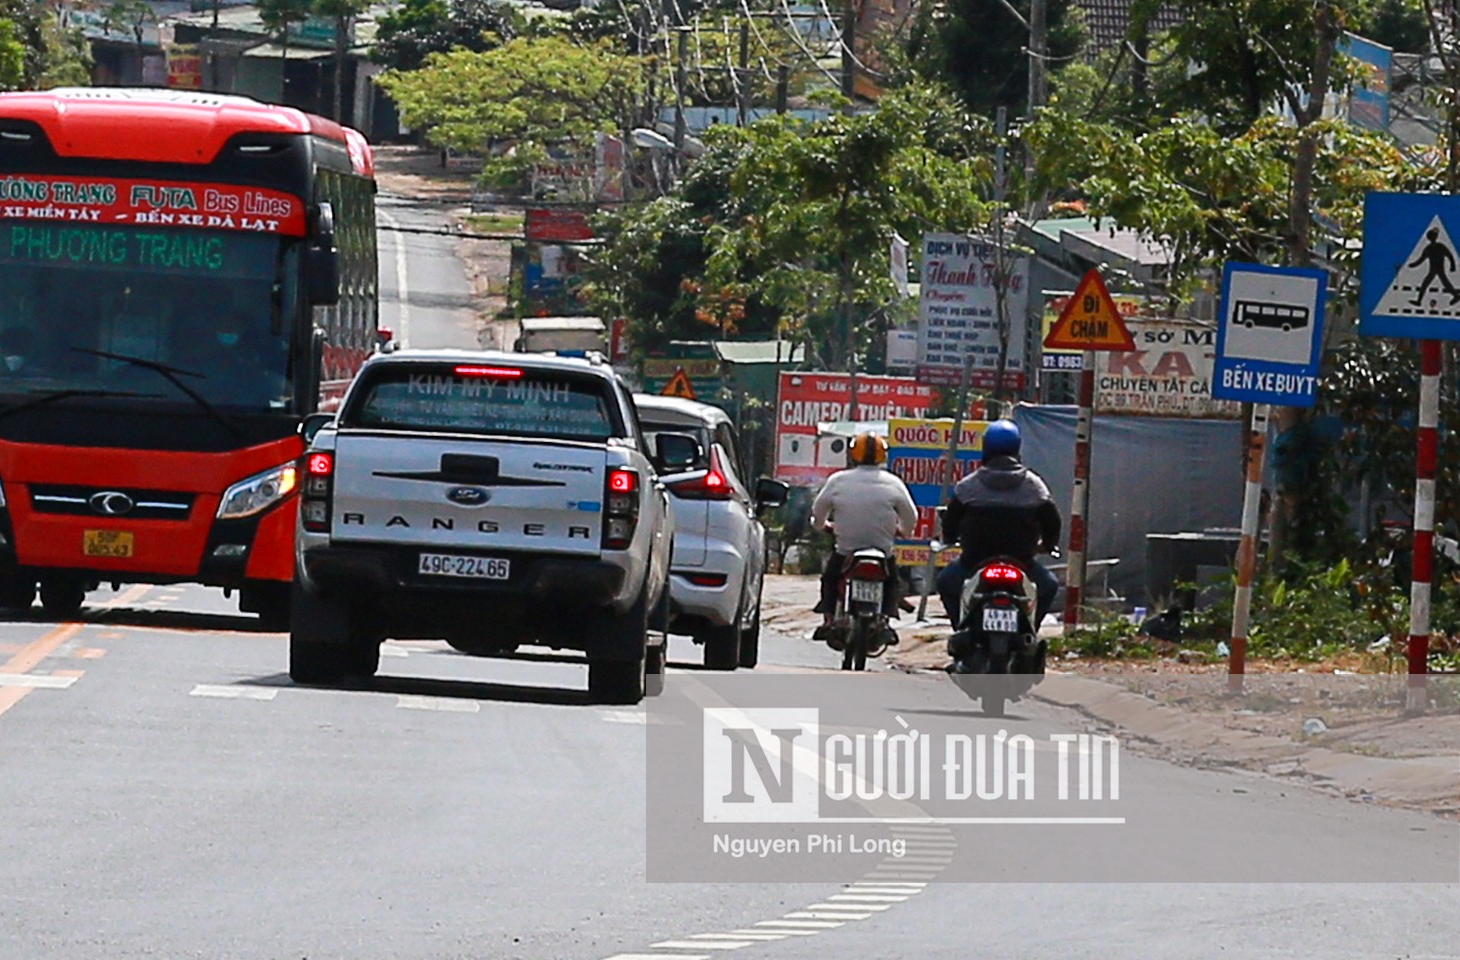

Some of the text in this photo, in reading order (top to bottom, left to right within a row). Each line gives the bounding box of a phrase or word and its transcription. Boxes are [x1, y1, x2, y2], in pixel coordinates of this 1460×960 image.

[52, 181, 117, 205] TRANG
[130, 185, 198, 210] FUTA
[204, 188, 239, 212] Bus
[242, 191, 291, 217] Lines
[4, 206, 25, 218] XE
[135, 208, 165, 224] BẾN
[177, 214, 204, 226] XE
[241, 218, 279, 233] LẠT
[134, 232, 223, 269] TRANG
[926, 260, 977, 286] Thanh
[408, 373, 453, 396] KIM
[506, 381, 570, 403] MINH
[1222, 362, 1253, 390] BẾN
[781, 399, 851, 427] CAMERA
[894, 422, 938, 443] QUỐC
[342, 512, 590, 540] RANGER
